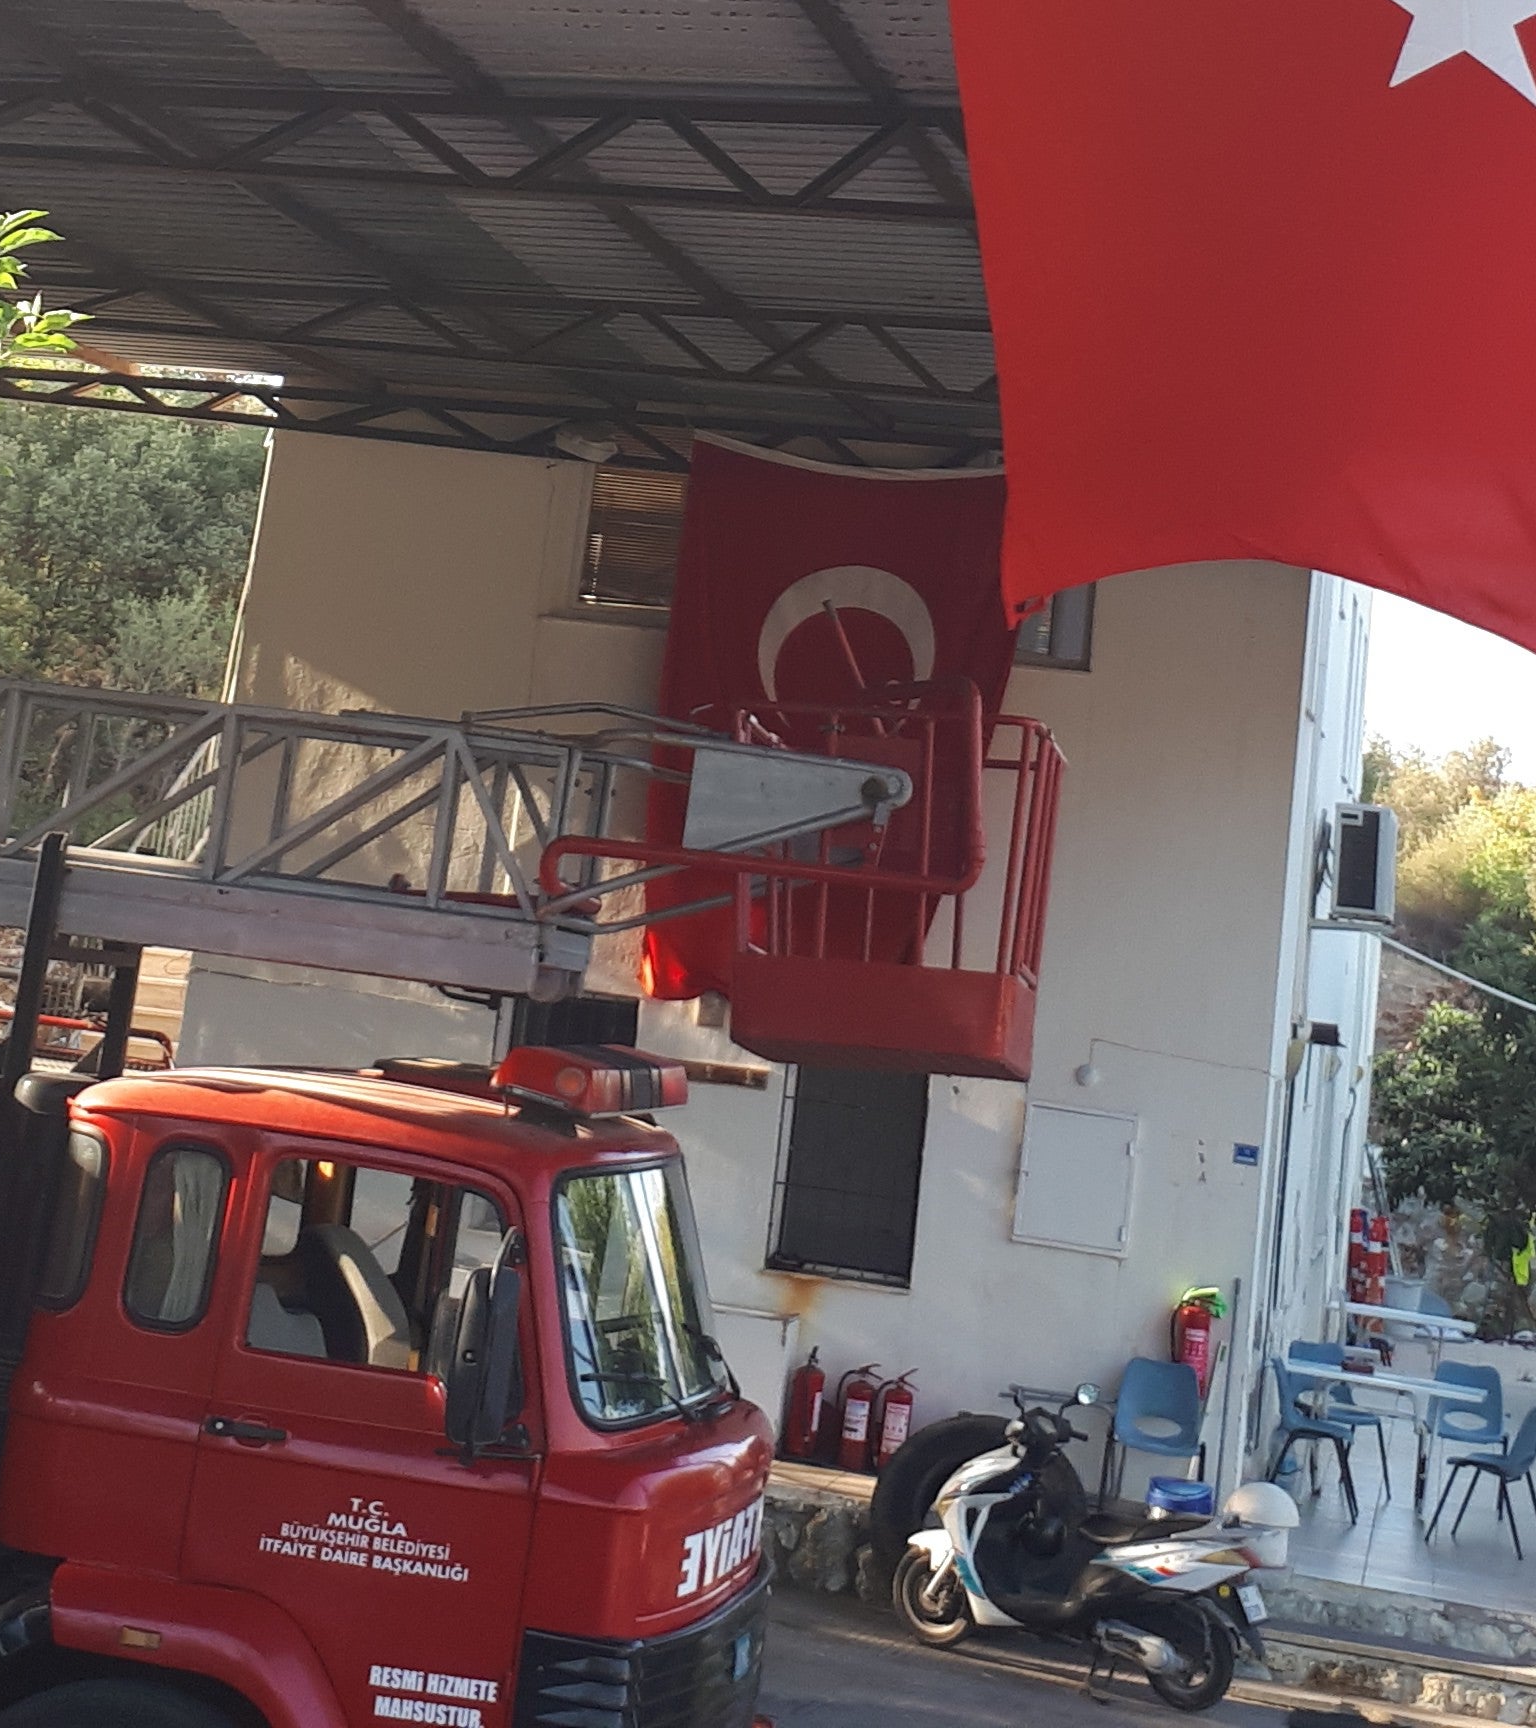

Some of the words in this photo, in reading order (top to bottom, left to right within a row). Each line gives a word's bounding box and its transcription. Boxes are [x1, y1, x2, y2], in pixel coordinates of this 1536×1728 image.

[327, 1512, 408, 1538] MUĞLA
[349, 1497, 390, 1517] T.C.
[259, 1532, 317, 1559] İTFAİYE
[320, 1546, 369, 1568] DAİRE
[372, 1556, 470, 1582] BAŞKANLIĞI
[280, 1520, 369, 1550] BÜYÜKŞEHİR
[372, 1535, 451, 1561] BELEDİYESİ
[369, 1664, 425, 1692] RESMİ
[425, 1672, 498, 1703] HİZMETE
